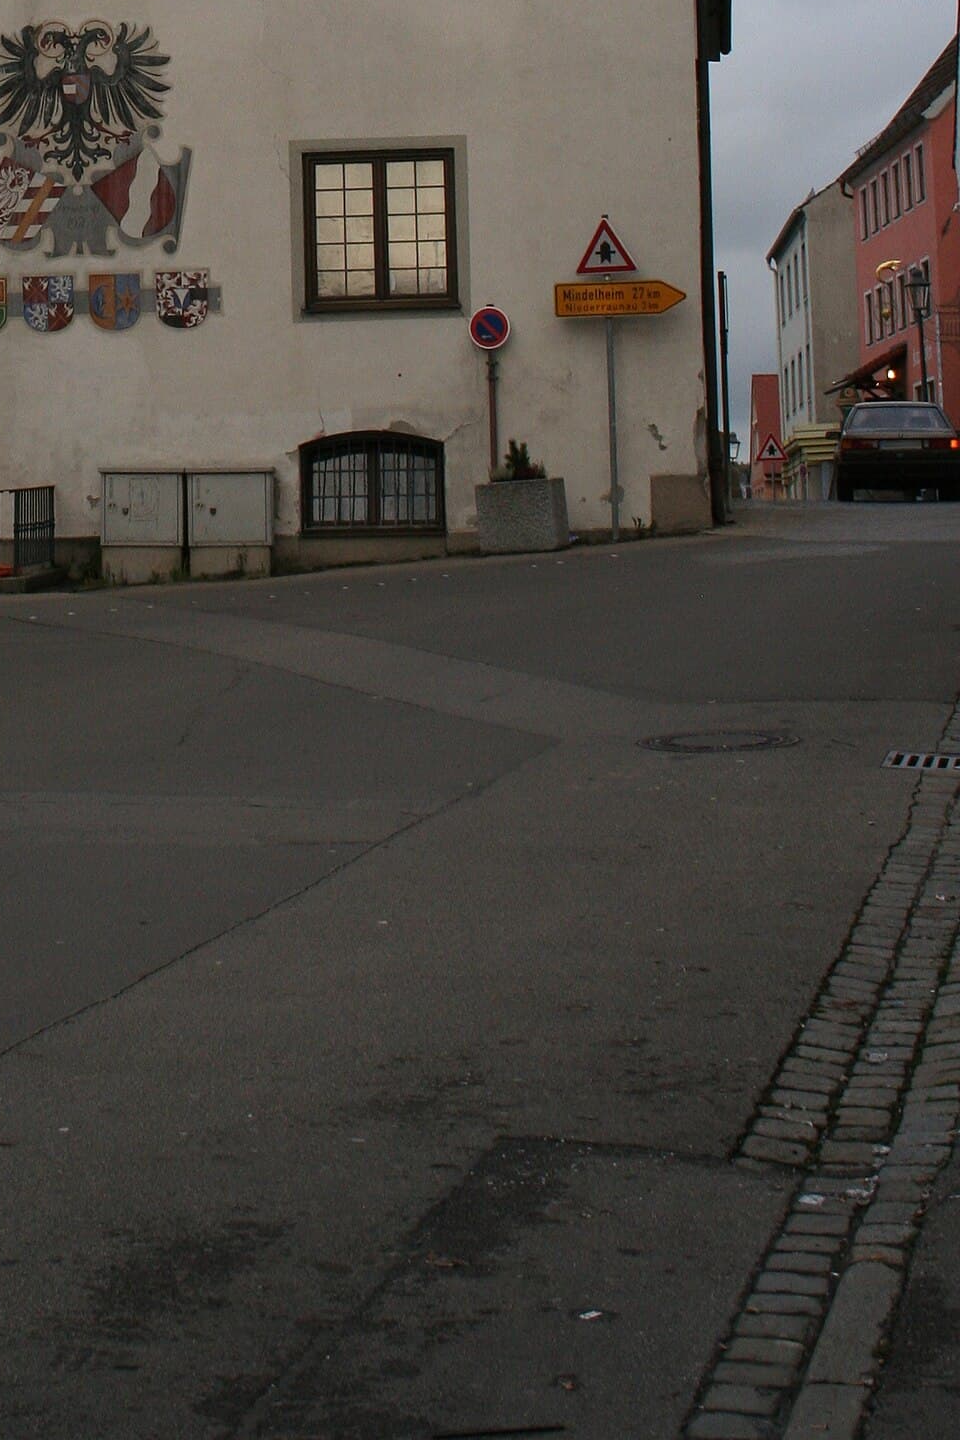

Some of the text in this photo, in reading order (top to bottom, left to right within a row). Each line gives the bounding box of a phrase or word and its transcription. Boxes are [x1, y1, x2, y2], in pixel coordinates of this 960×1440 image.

[563, 287, 660, 302] Mindelheim 27 km
